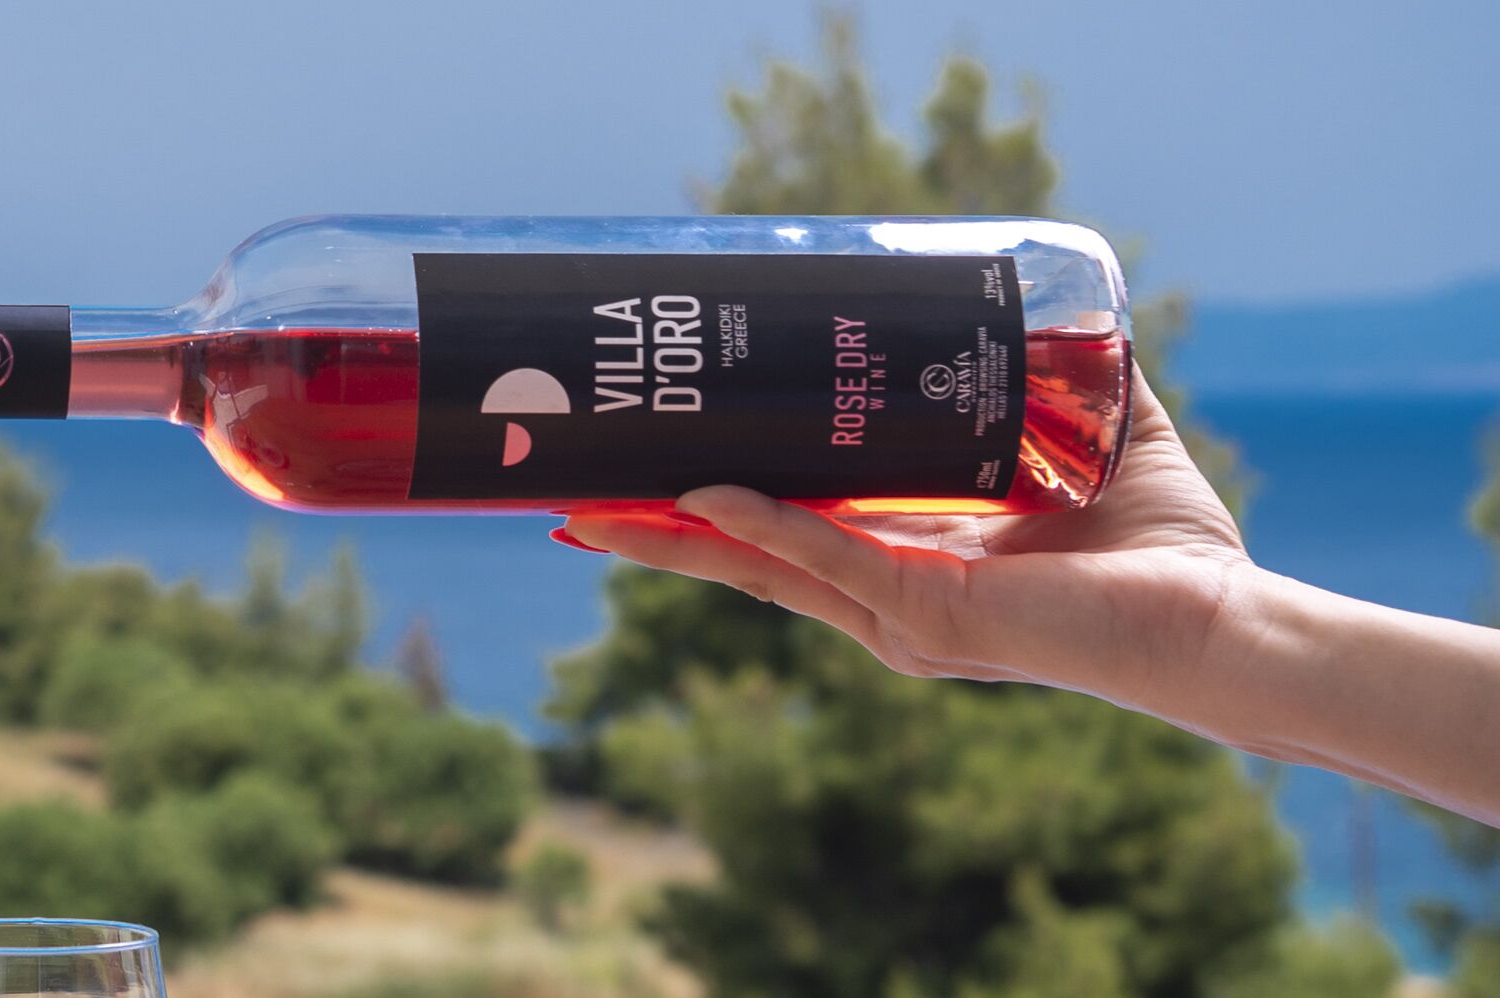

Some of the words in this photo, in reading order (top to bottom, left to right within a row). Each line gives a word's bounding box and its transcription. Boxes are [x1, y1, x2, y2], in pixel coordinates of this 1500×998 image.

[593, 298, 644, 413] VILLA
[651, 295, 703, 412] D'ORO
[718, 304, 734, 367] HALKIDIKI
[733, 304, 749, 358] GREECE
[833, 316, 868, 368] DRY
[977, 326, 988, 353] CARAVIA
[869, 353, 887, 410] WINE
[988, 341, 998, 387] THESSALONIKI
[831, 377, 868, 445] ROSE
[974, 398, 988, 436] PRODUCTION
[987, 388, 997, 423] ANCHIALOS
